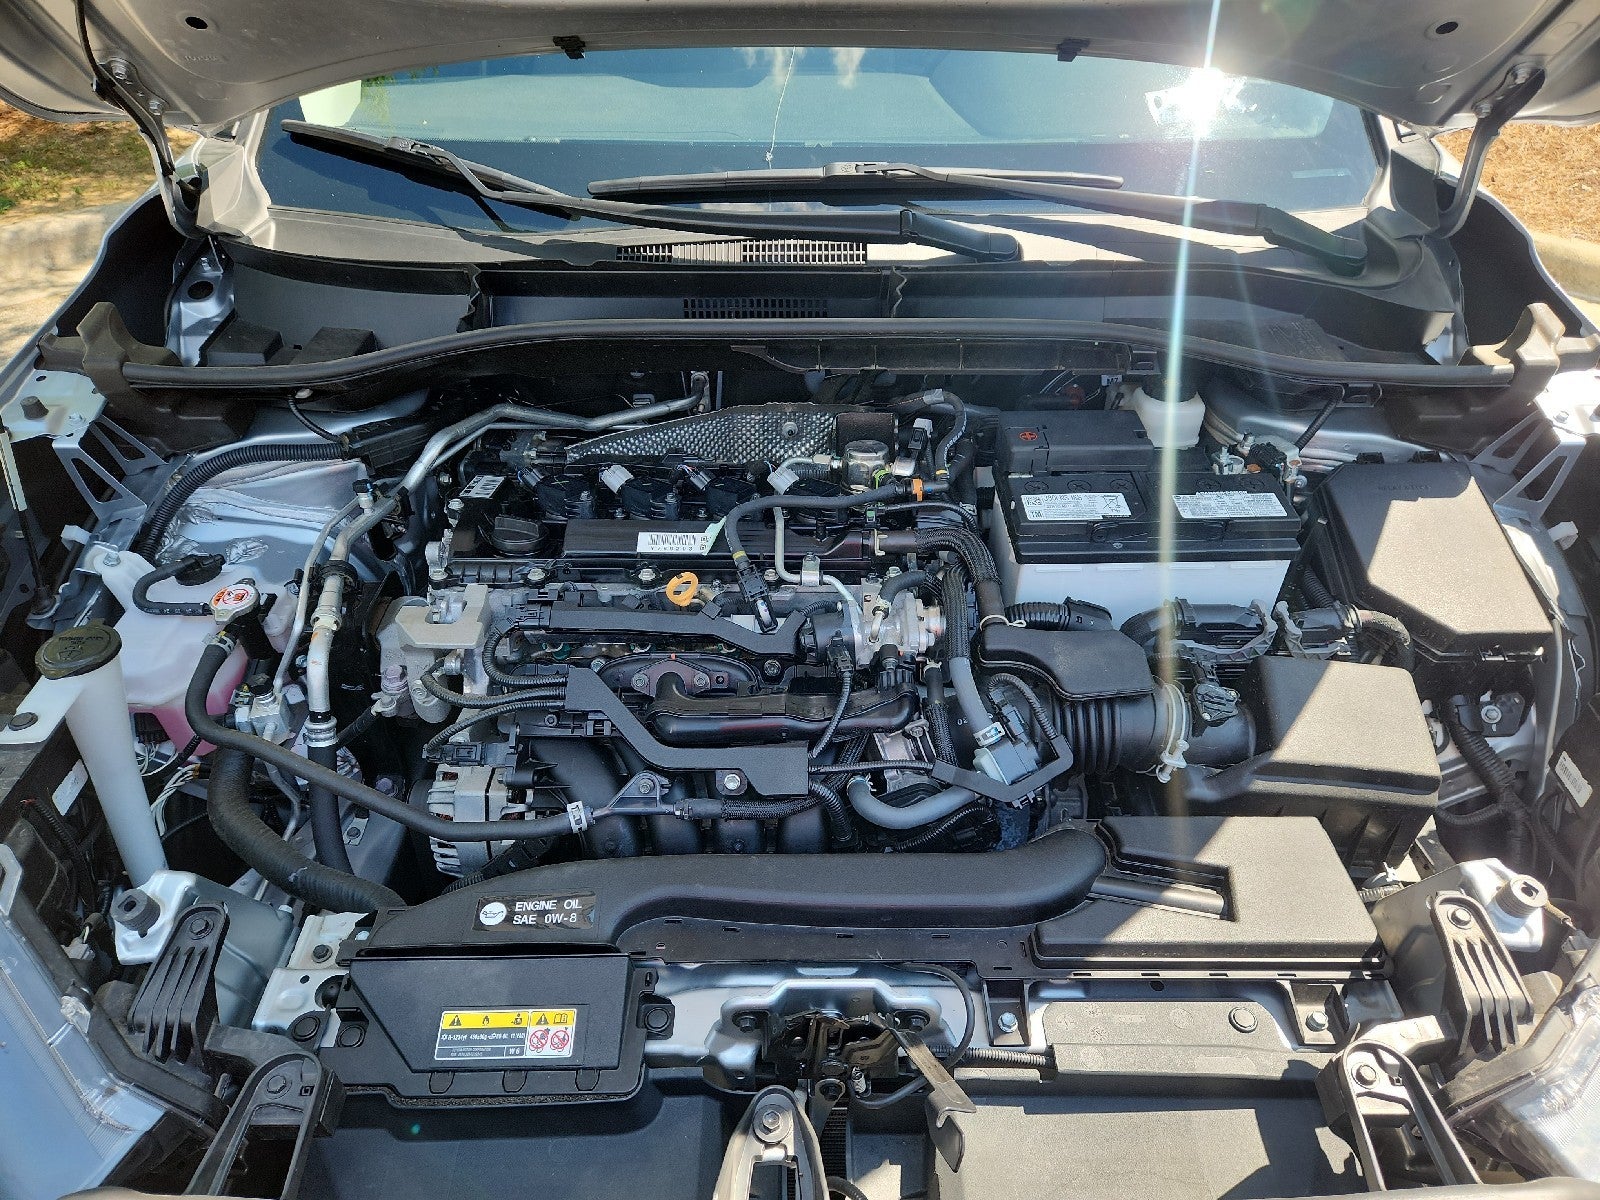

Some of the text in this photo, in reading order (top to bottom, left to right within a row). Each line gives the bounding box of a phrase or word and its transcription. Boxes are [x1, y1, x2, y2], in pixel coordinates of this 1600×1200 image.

[514, 899, 583, 912] ENGINE OIL
[512, 913, 577, 925] SAE 0W-8
